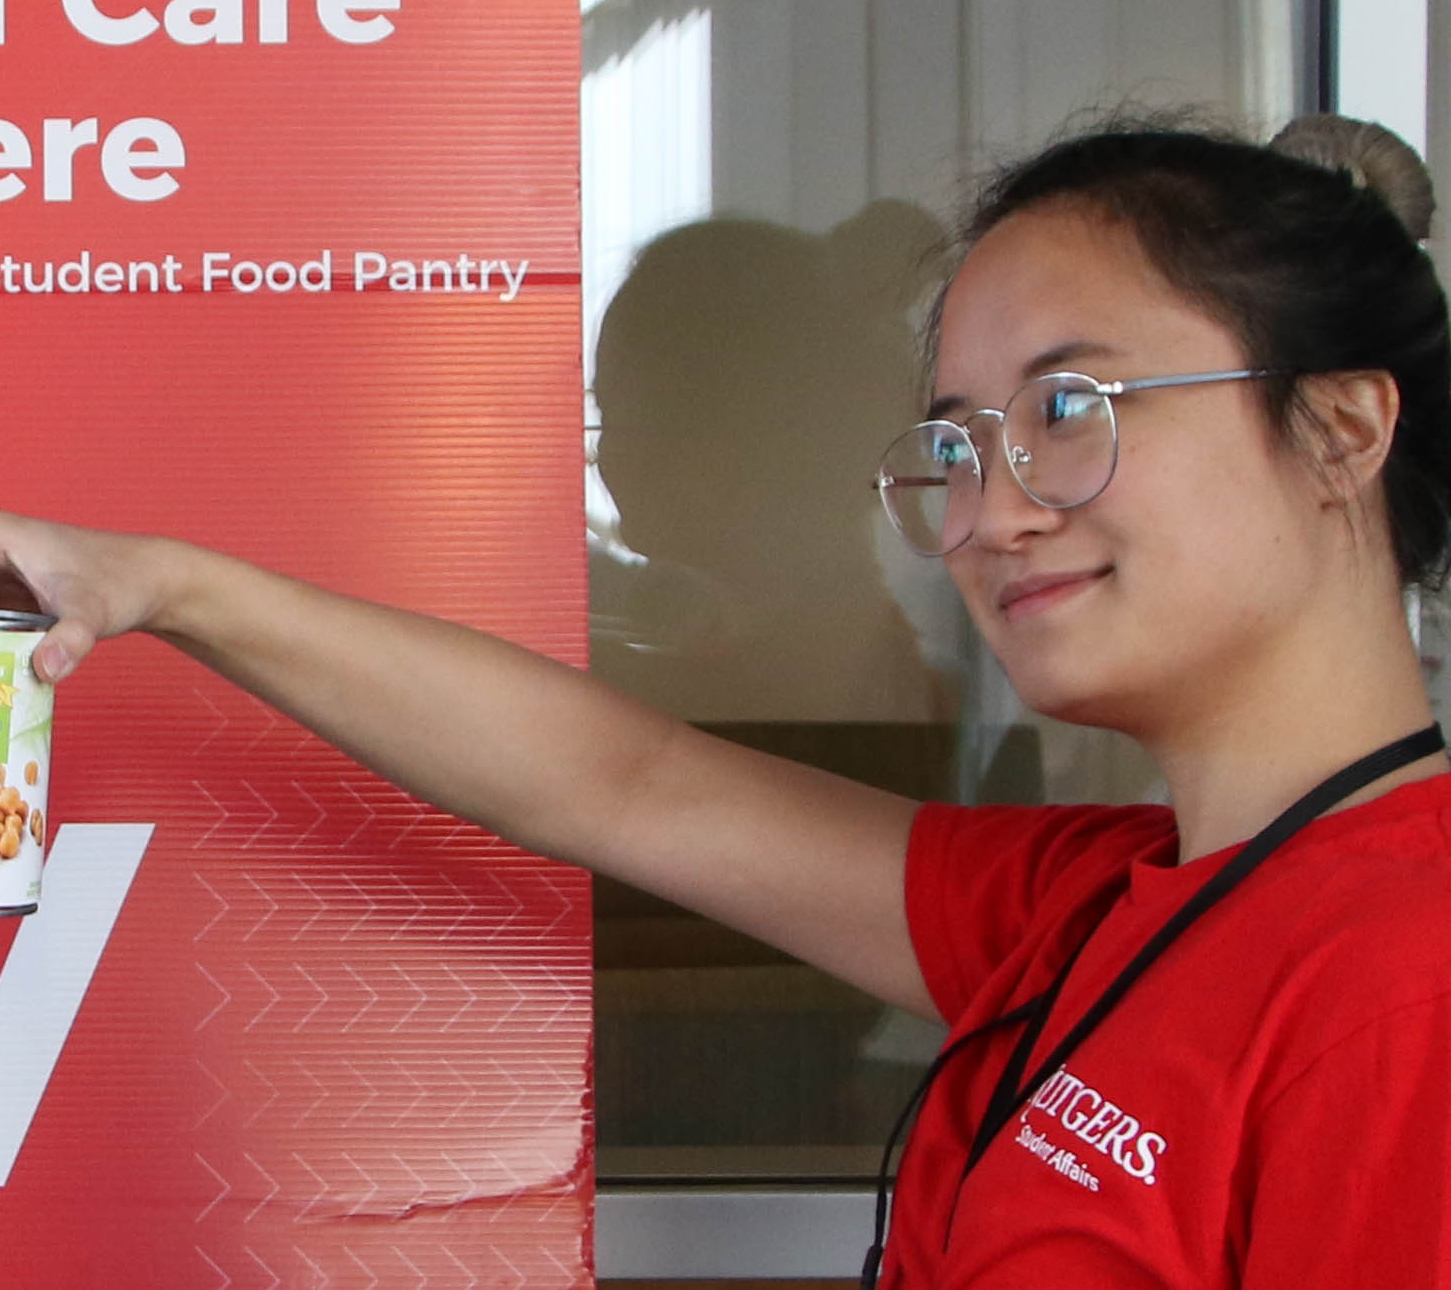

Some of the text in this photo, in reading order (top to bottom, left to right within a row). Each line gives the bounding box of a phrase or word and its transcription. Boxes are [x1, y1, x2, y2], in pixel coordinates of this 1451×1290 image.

[202, 249, 332, 293] Food
[354, 251, 529, 303] Pantry
[1048, 1149, 1100, 1192] Affairs
